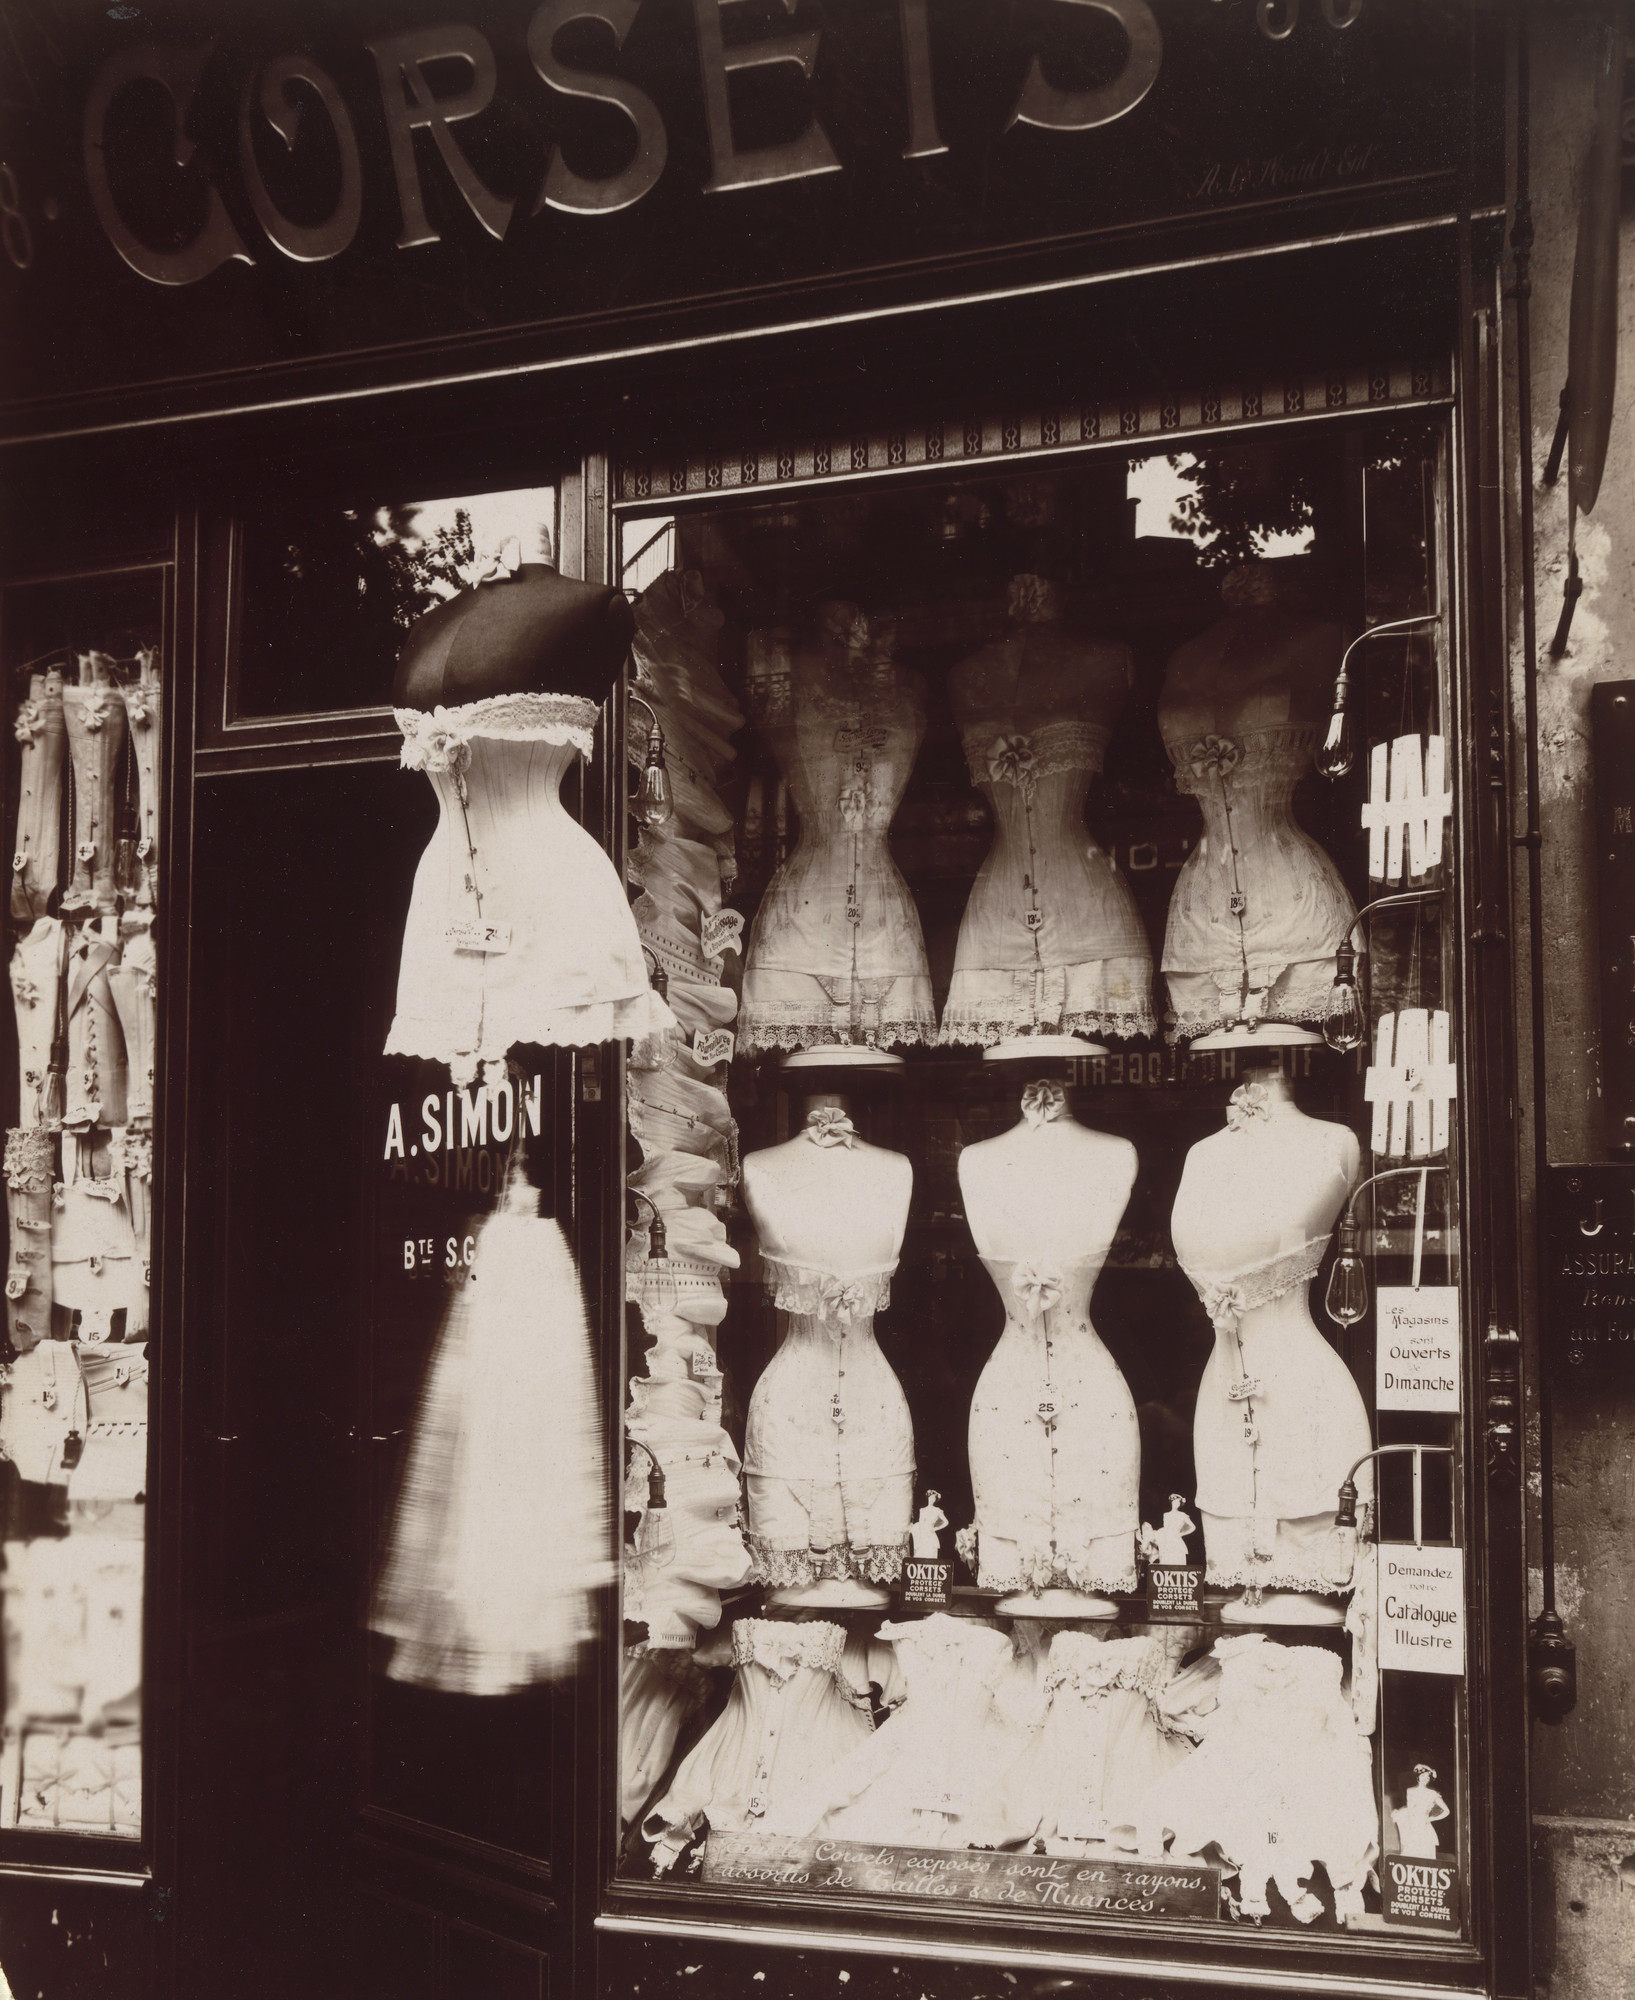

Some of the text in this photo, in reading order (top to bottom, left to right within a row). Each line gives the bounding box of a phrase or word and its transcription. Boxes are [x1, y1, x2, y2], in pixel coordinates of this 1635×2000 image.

[1391, 1315, 1449, 1329] Magasins
[1605, 1321, 1635, 1342] Fo
[1389, 1346, 1451, 1360] Ouverts
[1384, 1373, 1454, 1391] Dimanche
[1038, 1403, 1055, 1413] 25
[1388, 1562, 1453, 1579] Demandez
[1157, 1593, 1193, 1601] CORSETS
[1385, 1596, 1457, 1628] Catalogue
[815, 1841, 896, 1867] Corsets
[907, 1855, 990, 1874] exposés
[1006, 1860, 1071, 1881] sont
[1076, 1867, 1108, 1884] en
[720, 1864, 811, 1885] assortis
[815, 1866, 856, 1889] de
[864, 1867, 957, 1897] Tailles
[997, 1879, 1034, 1903] de
[1390, 1901, 1420, 1911] DOUBLENT
[1397, 1893, 1443, 1907] CORSETS
[1401, 1909, 1416, 1917] VOS
